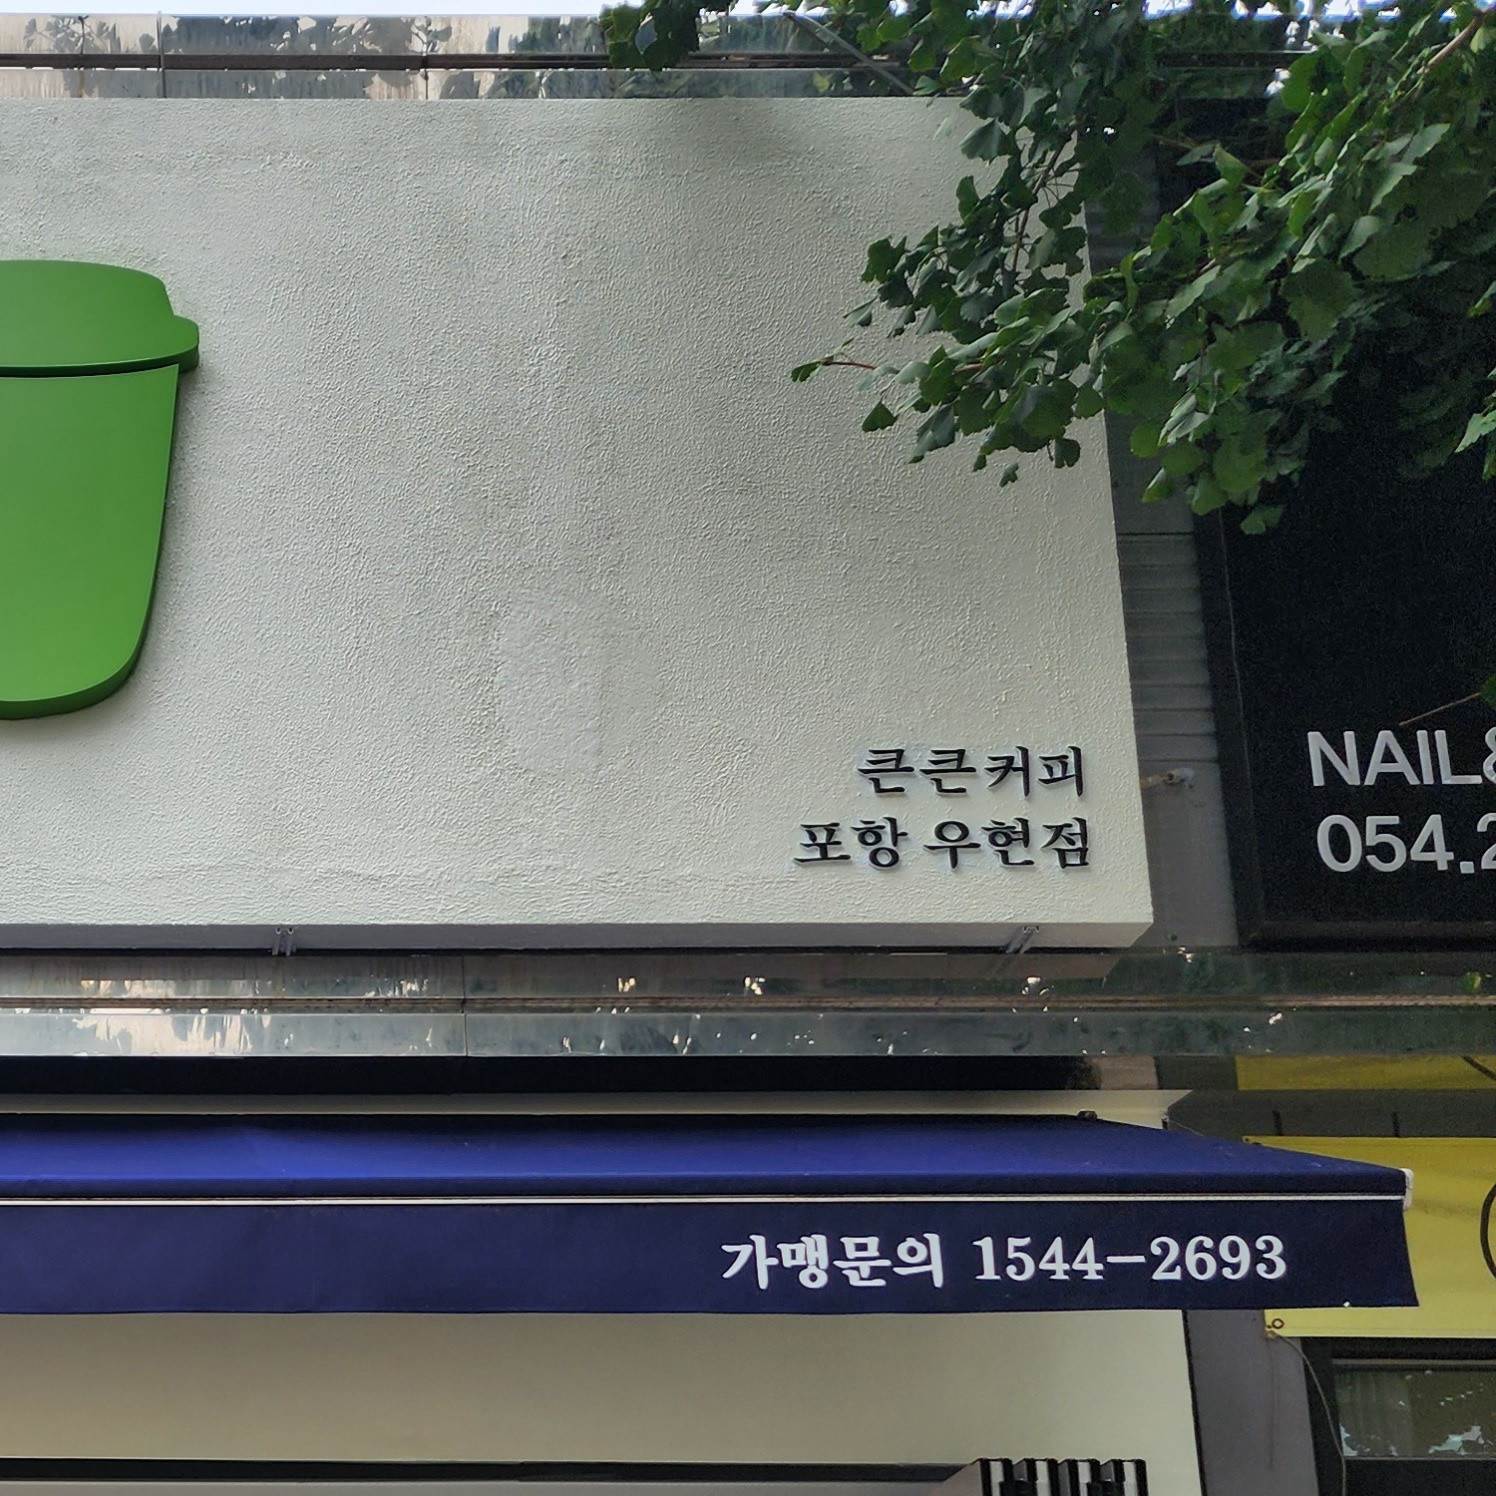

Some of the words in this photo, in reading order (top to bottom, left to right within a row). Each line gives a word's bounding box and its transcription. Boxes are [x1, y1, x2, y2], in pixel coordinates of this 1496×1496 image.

[856, 745, 1085, 798] 큰큰커피
[793, 816, 909, 869] 포항
[922, 816, 1090, 870] 우현점
[721, 1233, 943, 1290] 가맹문의
[971, 1235, 1287, 1281] 1544-2693
